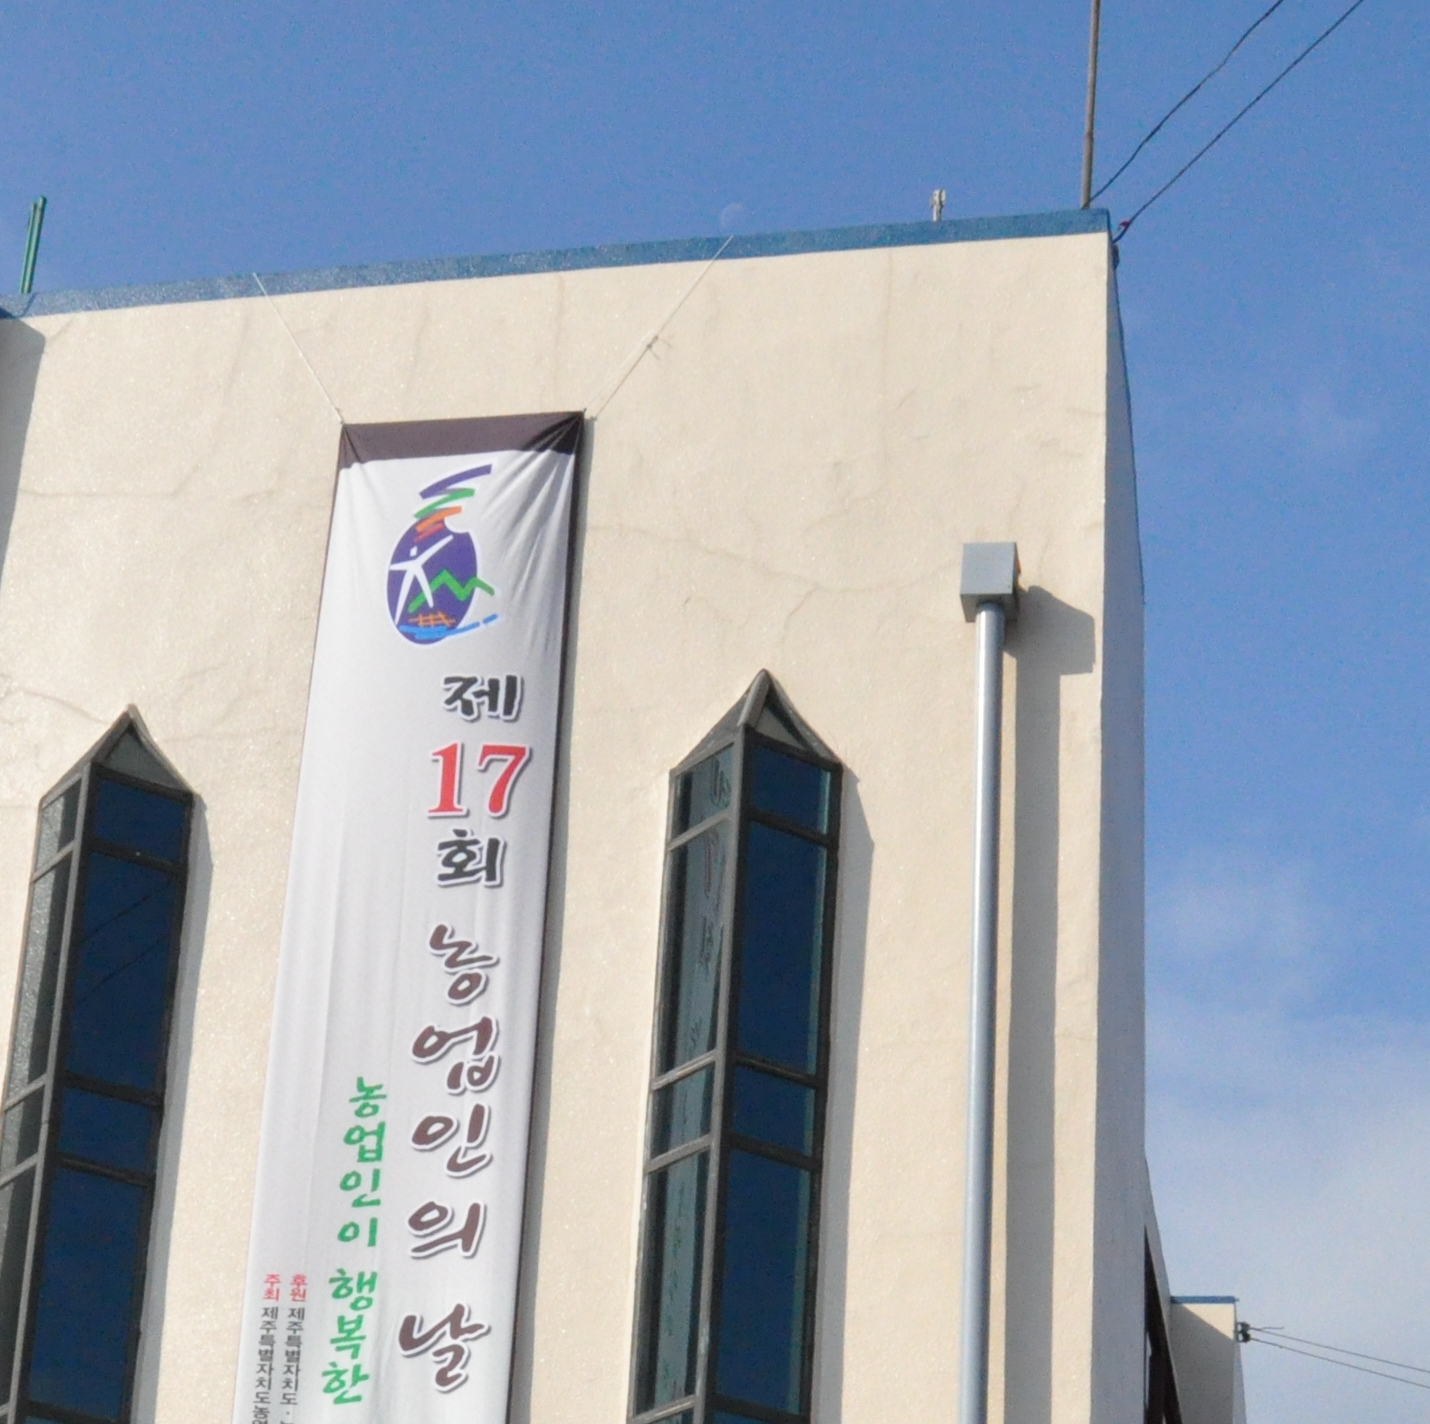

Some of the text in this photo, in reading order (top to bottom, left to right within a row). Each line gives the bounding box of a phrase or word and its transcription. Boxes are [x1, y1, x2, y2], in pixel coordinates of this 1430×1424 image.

[337, 1077, 388, 1249] 농업인이
[321, 1268, 378, 1405] 행복한
[398, 1305, 487, 1387] 날
